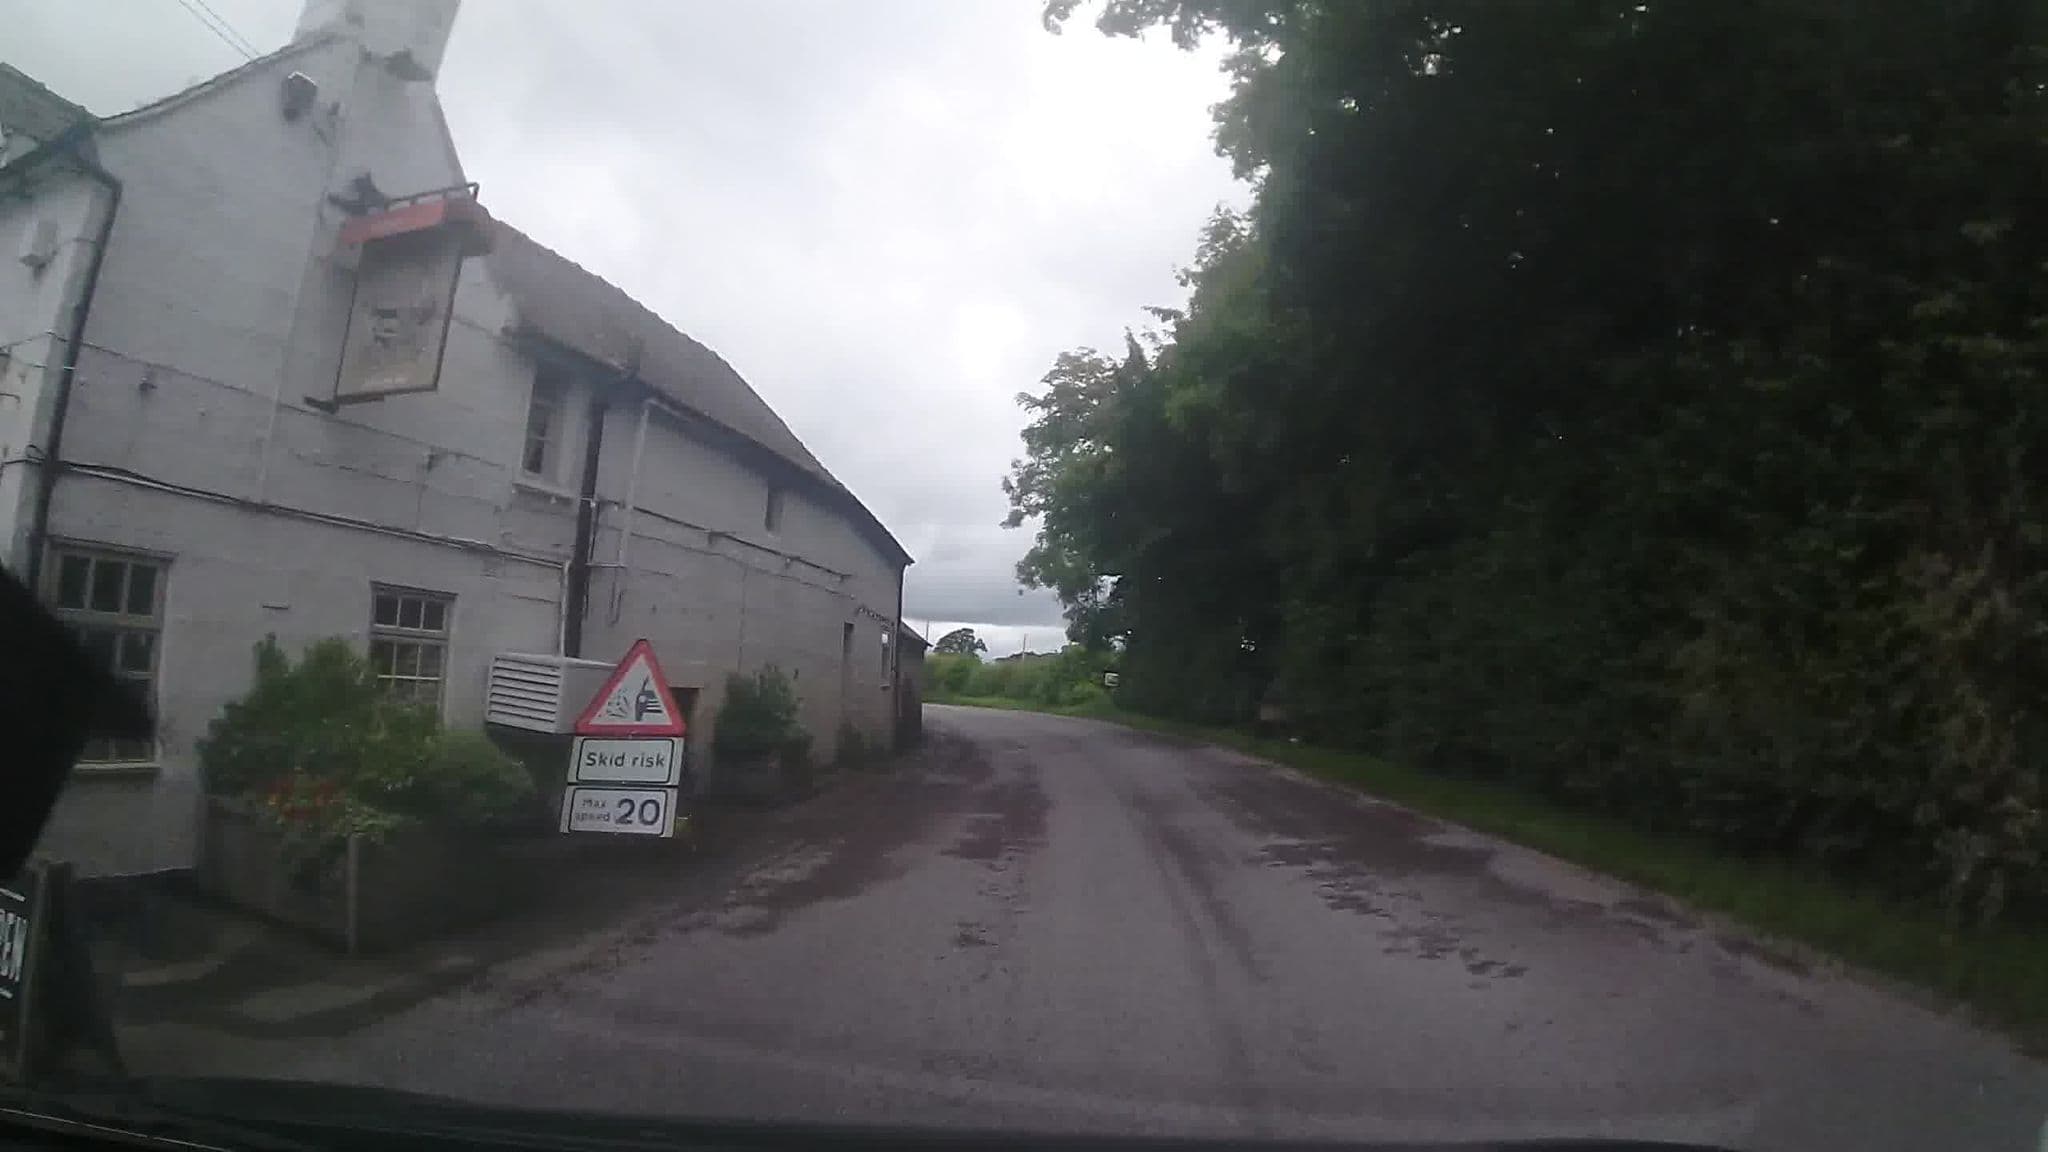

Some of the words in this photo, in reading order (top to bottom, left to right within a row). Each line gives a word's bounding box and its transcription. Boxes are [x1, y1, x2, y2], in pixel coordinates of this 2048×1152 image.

[585, 752, 626, 767] Skid
[633, 752, 665, 768] risk
[616, 798, 660, 826] 20
